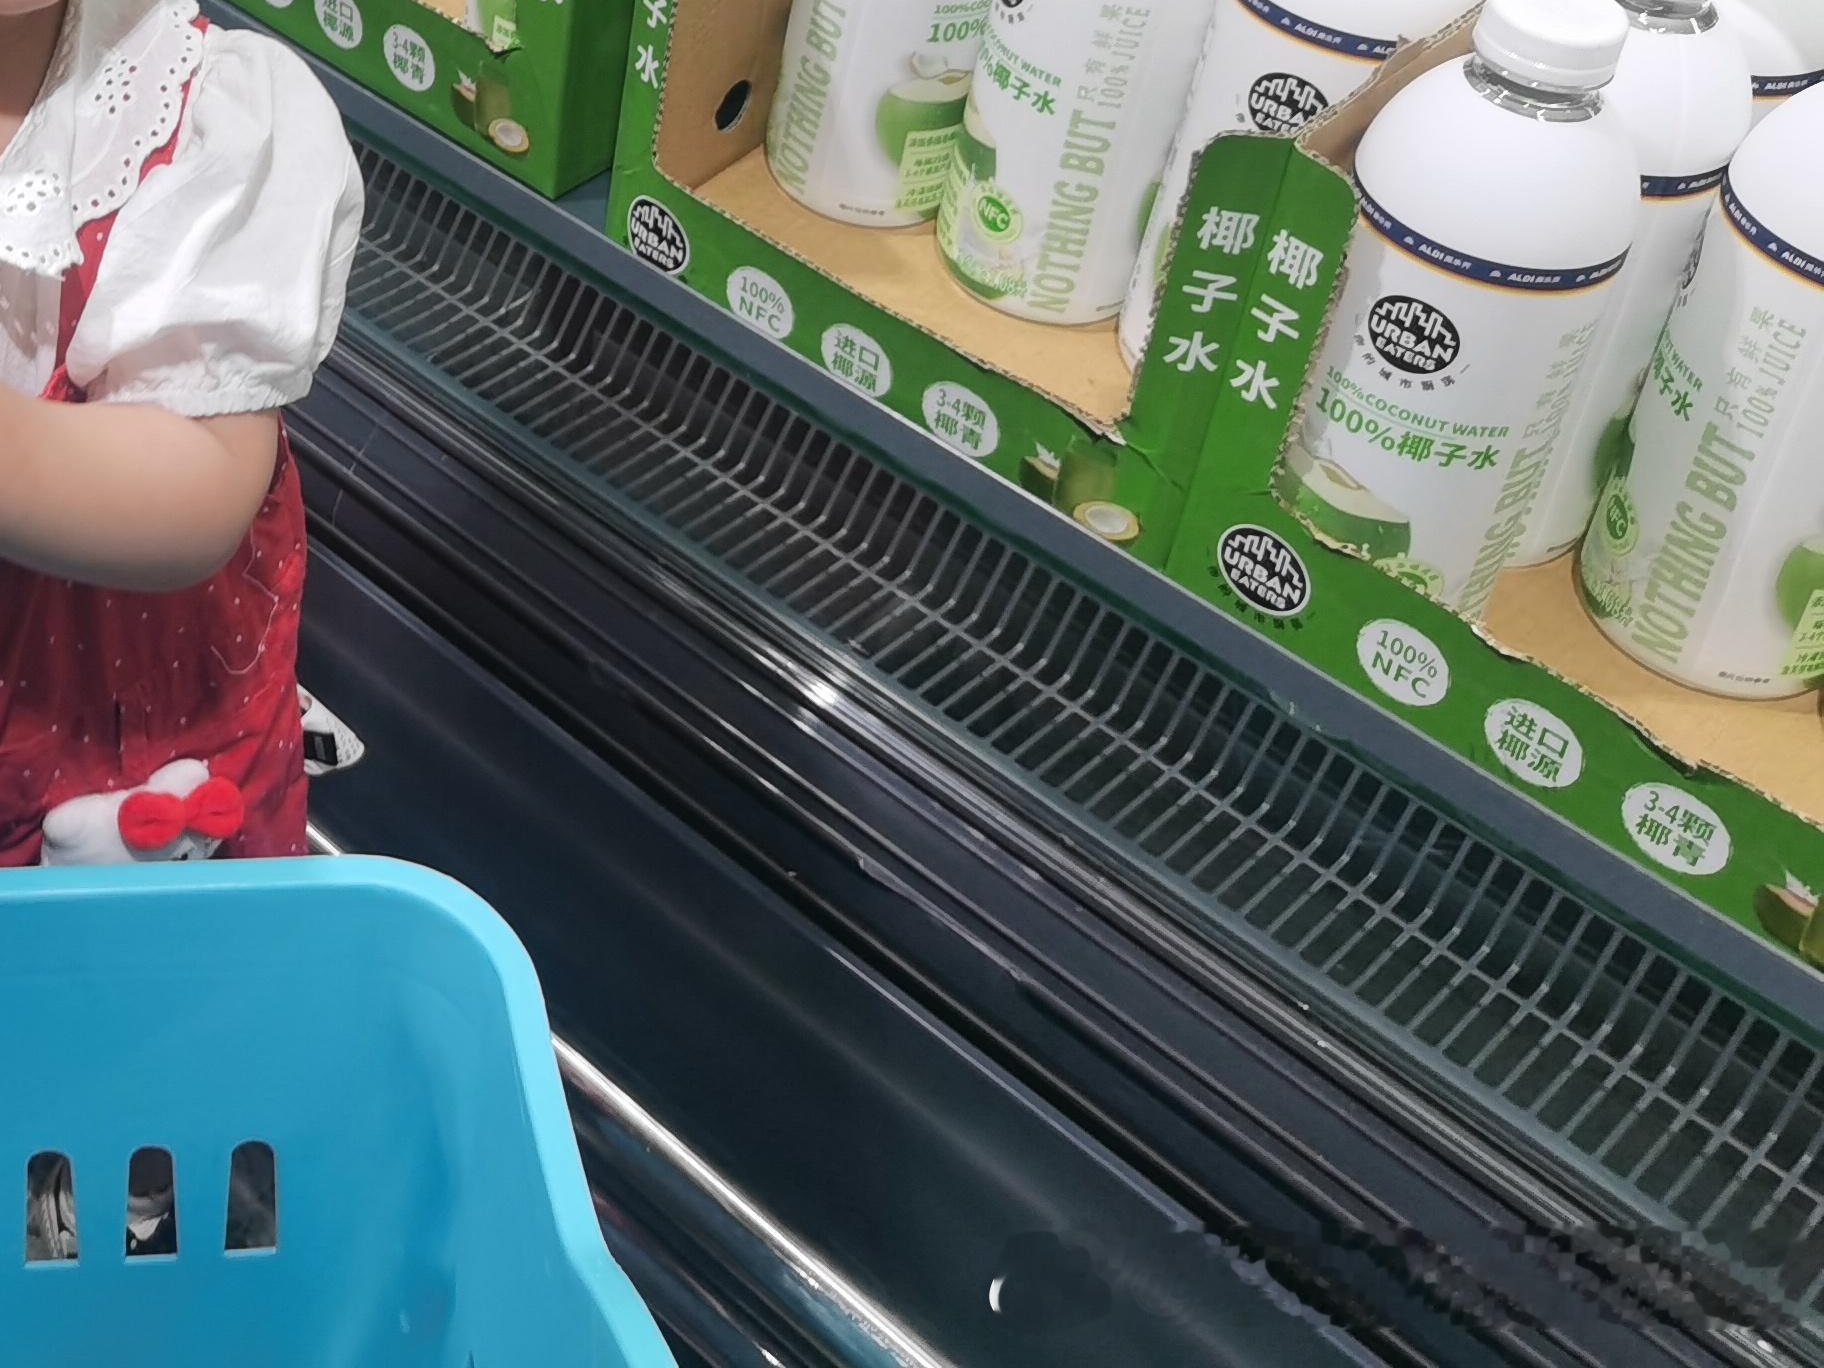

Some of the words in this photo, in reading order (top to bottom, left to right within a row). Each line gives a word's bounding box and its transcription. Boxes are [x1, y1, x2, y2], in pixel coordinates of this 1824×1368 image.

[1112, 4, 1152, 62] JUICE
[1021, 60, 1063, 88] WATER
[774, 55, 833, 196] NOTHING
[1060, 107, 1118, 178] BUT
[631, 219, 684, 261] URBAN
[977, 198, 1010, 230] NFC
[634, 239, 676, 270] EATERS
[1026, 181, 1099, 314] NOTHING
[738, 298, 782, 333] NFC
[739, 276, 785, 315] 100%
[1163, 205, 1261, 374] 椰子水
[1229, 229, 1325, 409] 椰子水
[1371, 313, 1455, 361] URBAN
[834, 330, 882, 371] 进口
[1375, 338, 1439, 372] EATERS
[1763, 319, 1807, 387] JUICE
[936, 387, 987, 431] 3-4颗
[1315, 384, 1501, 471] 100%椰子水
[1326, 365, 1450, 437] 100%COCONUT
[1453, 422, 1510, 440] WATER
[1631, 500, 1727, 664] NOTHING
[1684, 420, 1756, 513] BUT
[1223, 546, 1306, 606] URBAN
[1231, 569, 1290, 610] EATERS
[1371, 655, 1432, 700] NFC
[1377, 628, 1439, 680] 100%
[1503, 696, 1572, 756] 进口
[1496, 729, 1561, 784] 椰源
[1636, 813, 1706, 868] 椰青
[1644, 789, 1718, 844] 3-4颗
